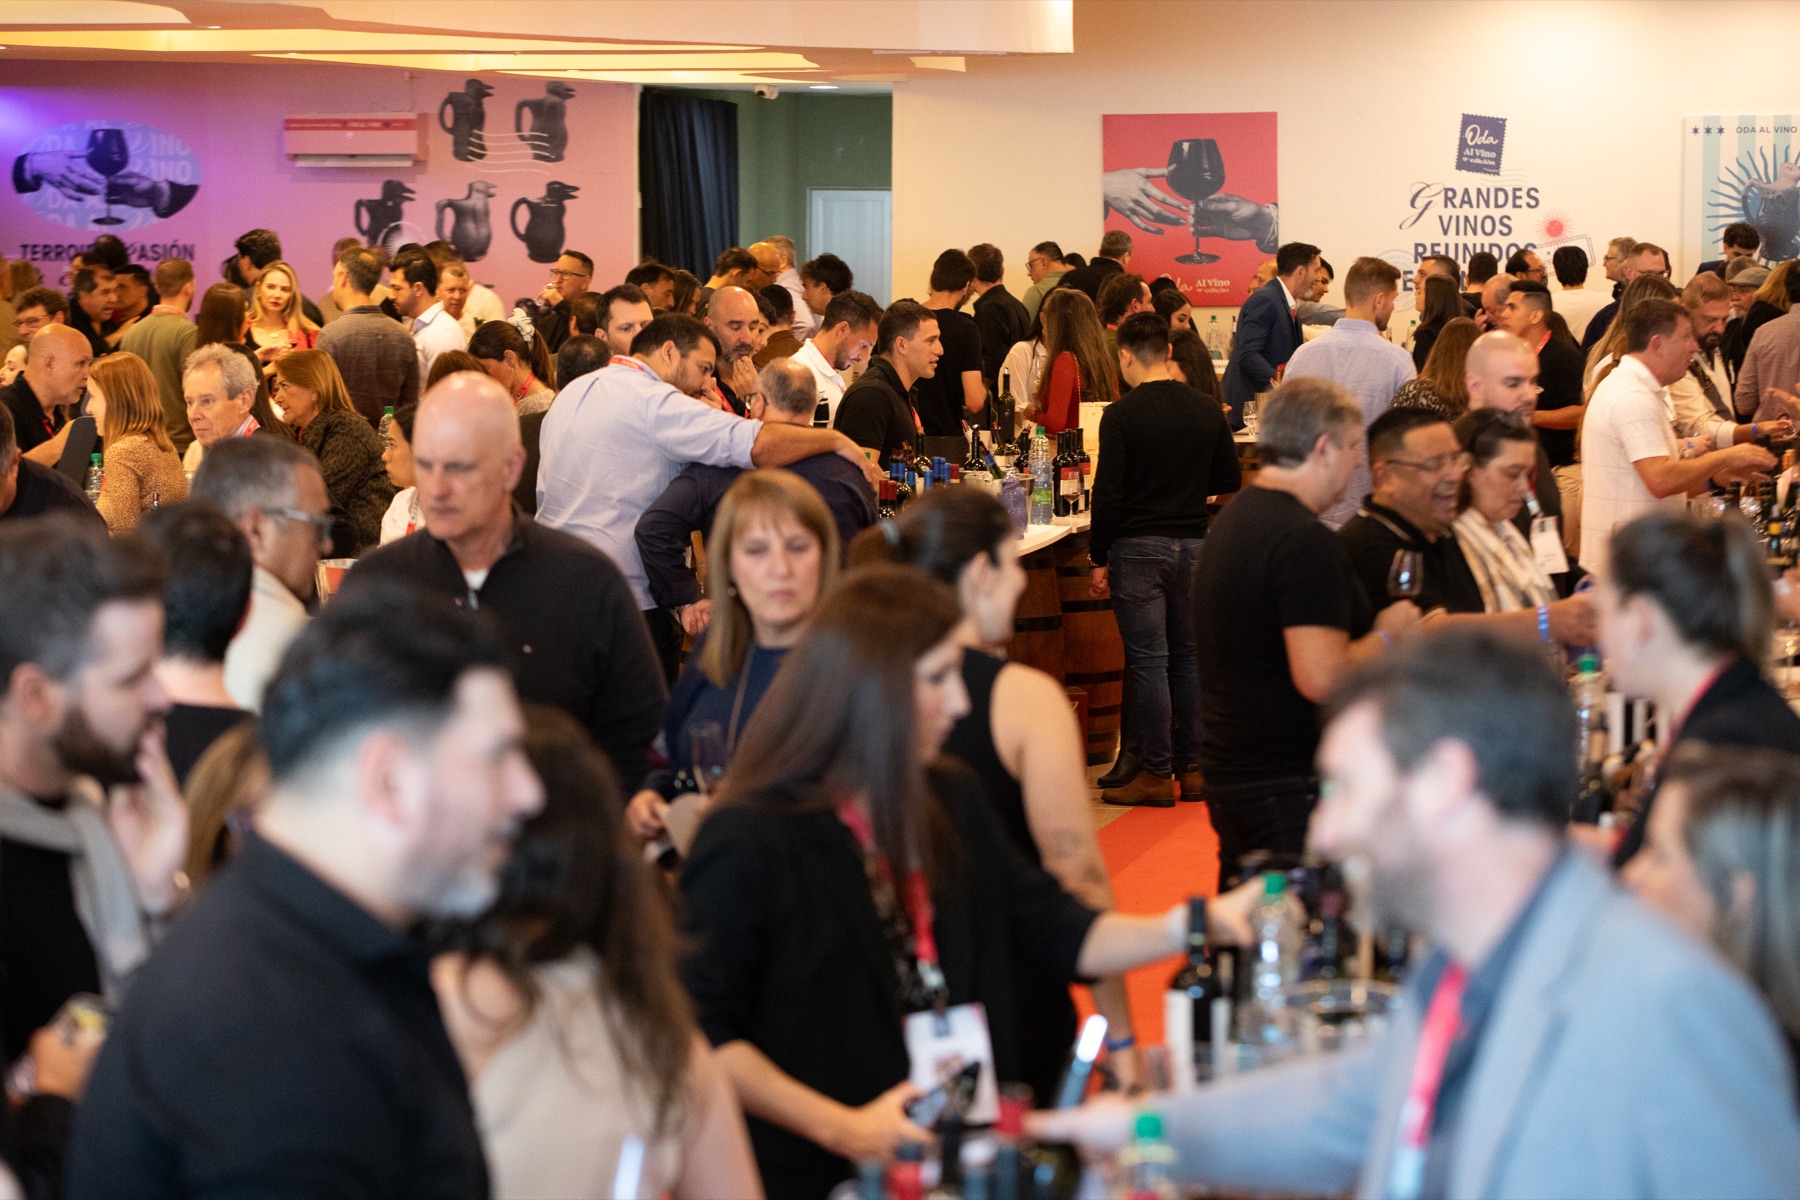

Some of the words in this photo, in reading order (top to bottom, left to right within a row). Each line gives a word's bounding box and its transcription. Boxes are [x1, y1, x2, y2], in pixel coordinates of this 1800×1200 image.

[1465, 124, 1499, 146] Oda
[1736, 126, 1757, 134] ODA
[1758, 126, 1771, 134] AL
[1774, 125, 1798, 134] VINO
[1463, 148, 1474, 156] Al
[1474, 148, 1497, 159] Vino
[1399, 182, 1540, 230] GRANDES
[1438, 214, 1513, 237] VINOS
[1195, 279, 1206, 288] Al
[1206, 278, 1231, 287] Vino
